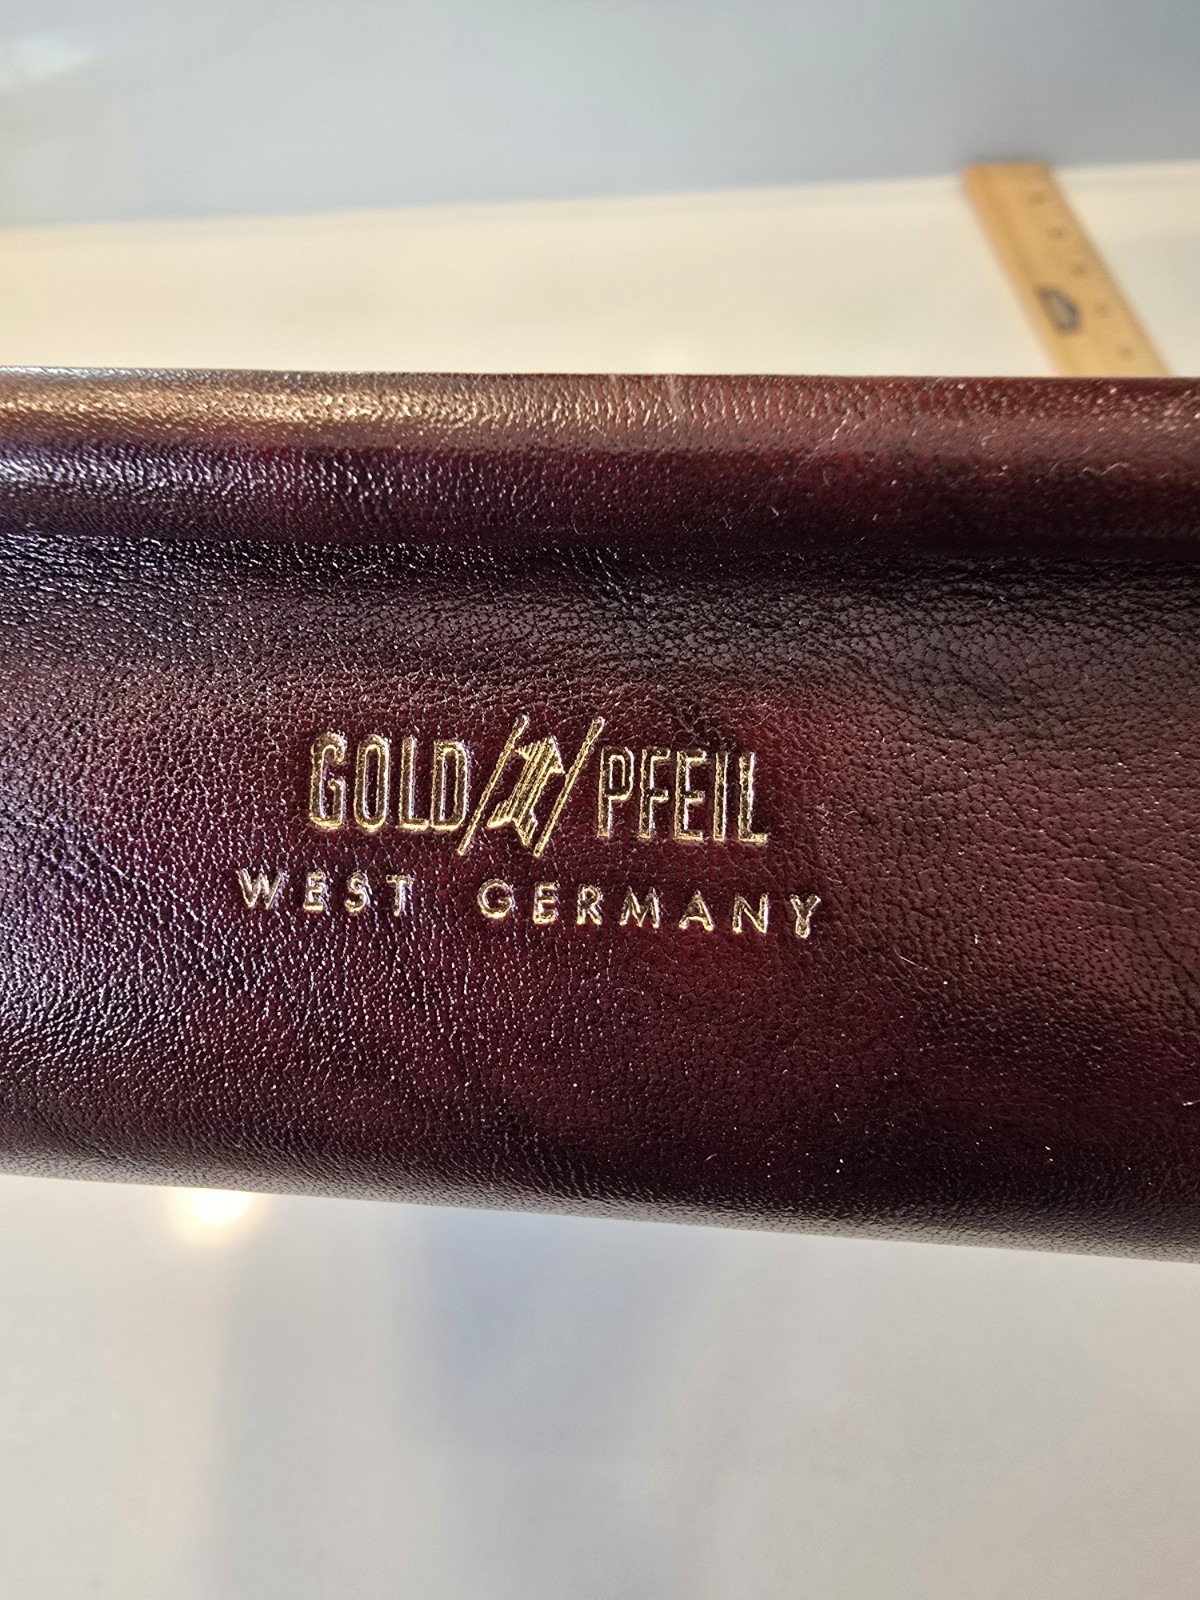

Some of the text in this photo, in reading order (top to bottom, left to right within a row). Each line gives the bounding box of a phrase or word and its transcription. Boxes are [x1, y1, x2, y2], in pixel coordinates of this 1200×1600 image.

[309, 731, 768, 845] GOLD PFEIL
[235, 868, 822, 939] WEST GERMANY
